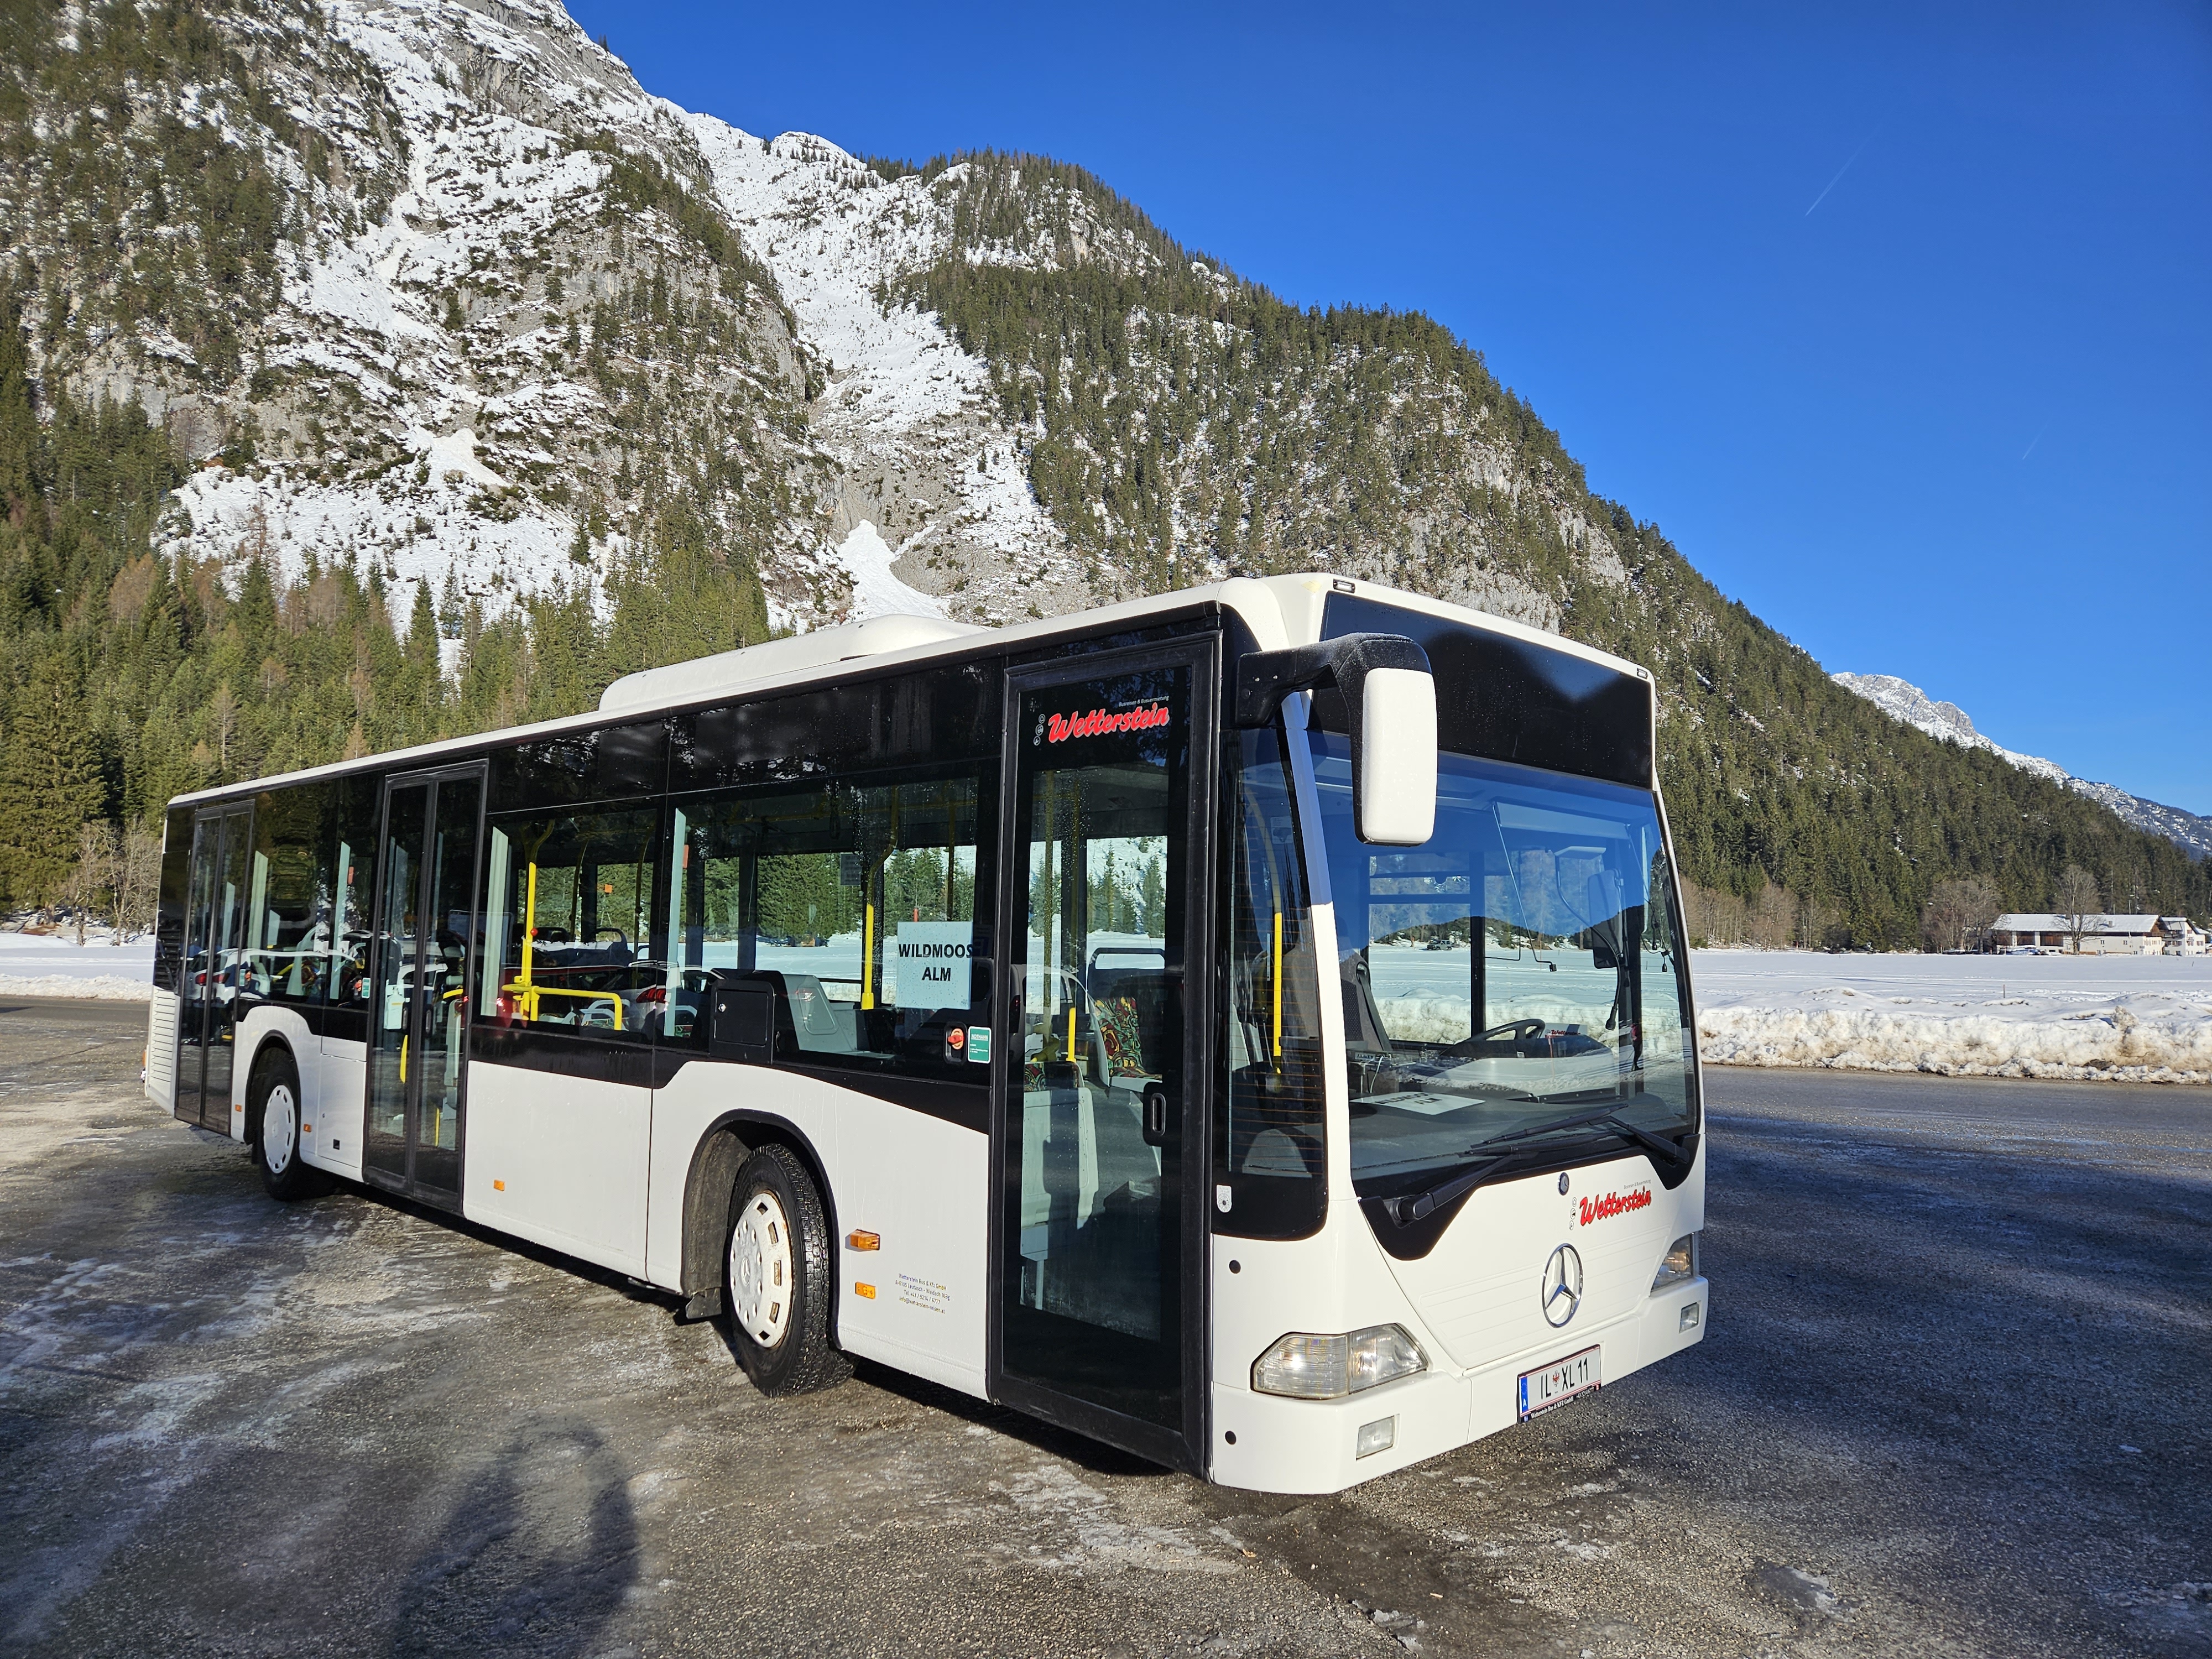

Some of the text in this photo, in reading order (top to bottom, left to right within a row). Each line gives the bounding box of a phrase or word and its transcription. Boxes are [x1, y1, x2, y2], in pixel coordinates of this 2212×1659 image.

[1048, 702, 1170, 743] Wetterstein
[899, 943, 973, 958] WILDMOOS
[922, 967, 951, 982] ALM
[1579, 1186, 1652, 1226] Wetterstein
[899, 1273, 918, 1283] Wetterstein
[908, 1283, 922, 1292] Leutasch
[926, 1288, 941, 1297] Weidach
[1541, 1357, 1588, 1400] IL XL 11
[1522, 1399, 1527, 1407] A
[1531, 1407, 1548, 1418] Wetterstein
[1564, 1396, 1574, 1405] GmbH
